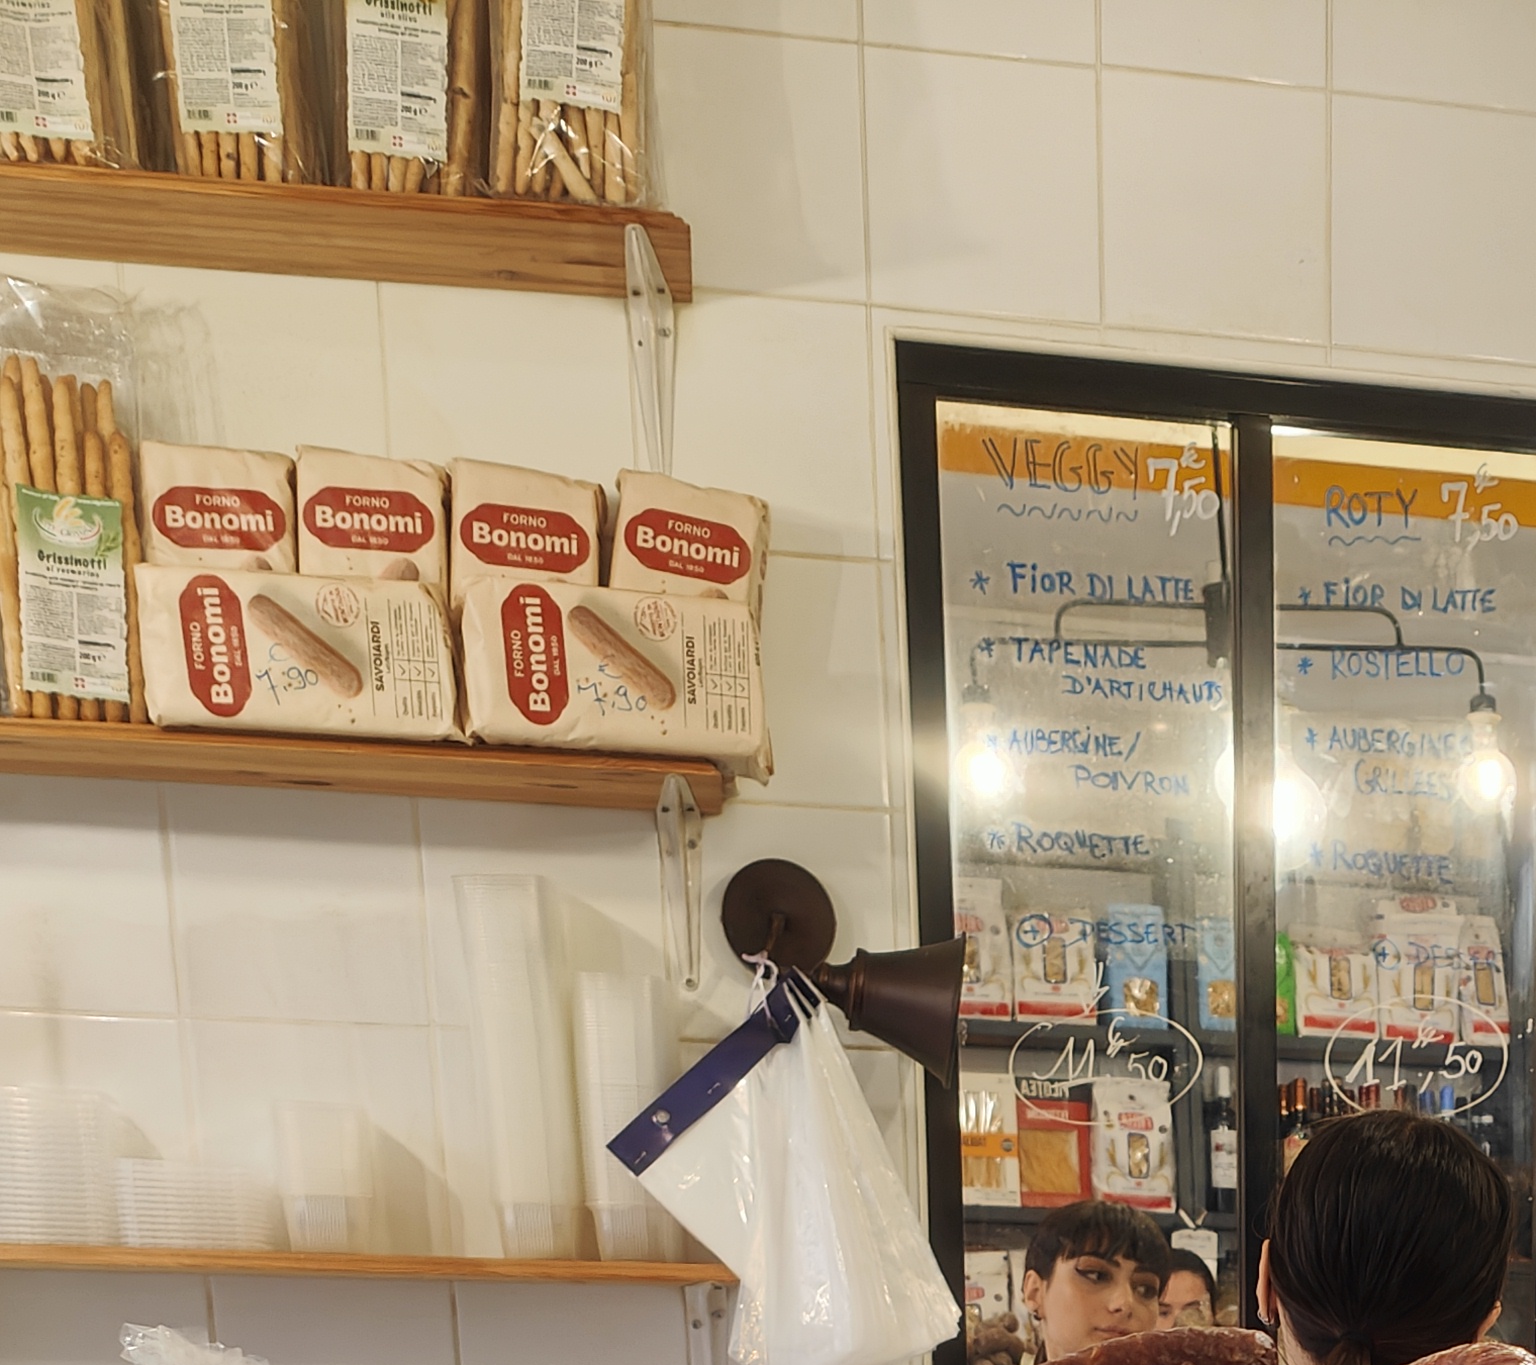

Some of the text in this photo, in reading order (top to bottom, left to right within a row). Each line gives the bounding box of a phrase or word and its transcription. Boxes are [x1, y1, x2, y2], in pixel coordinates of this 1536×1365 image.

[981, 434, 1140, 503] VEGGY
[194, 493, 241, 508] FORNO
[345, 495, 390, 509] FORNO
[1147, 458, 1221, 536] 7,50
[1325, 485, 1418, 530] ROTY
[1441, 481, 1519, 551] 7,50
[164, 505, 275, 533] Bonomi
[314, 505, 424, 535] Bonomi
[472, 521, 579, 556] Bonomi
[502, 512, 547, 529] FORNO
[667, 519, 711, 539] FORNO
[636, 525, 740, 568] Bonomi
[1126, 576, 1195, 602] LATTE
[1401, 587, 1425, 613] DI
[1431, 588, 1497, 615] LATTE
[193, 622, 206, 671] FORNO
[196, 586, 234, 705] Bonomi
[370, 621, 385, 692] SAVOIARDI
[512, 629, 525, 678] FORNO
[519, 595, 552, 712] Bonomi
[1009, 637, 1148, 671] TAPENADE
[686, 635, 696, 704] SAVOIARDI
[1074, 764, 1191, 796] POIVRON
[1332, 839, 1453, 884] ROQUETTE
